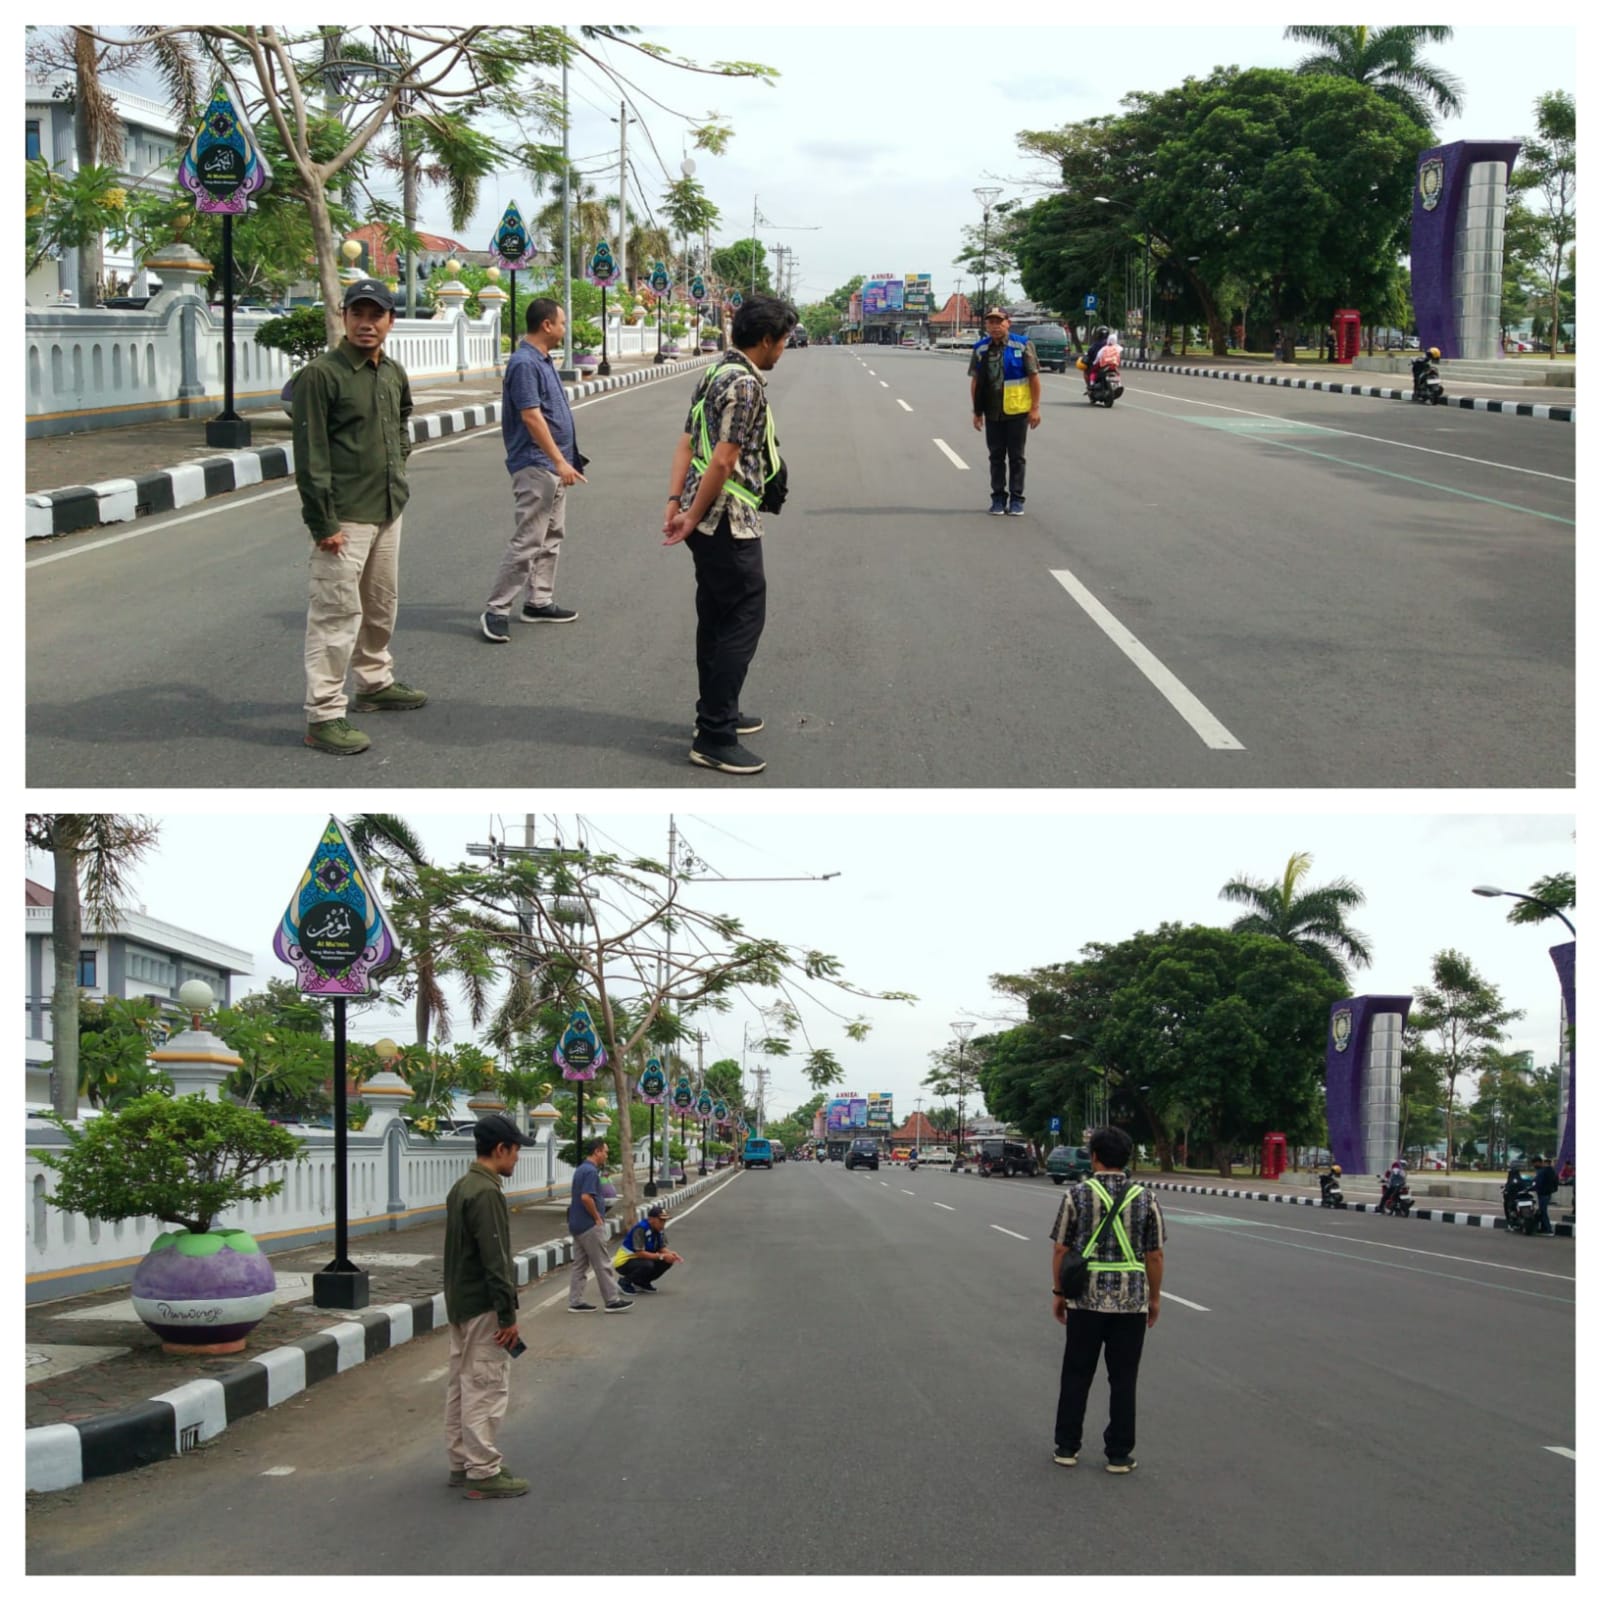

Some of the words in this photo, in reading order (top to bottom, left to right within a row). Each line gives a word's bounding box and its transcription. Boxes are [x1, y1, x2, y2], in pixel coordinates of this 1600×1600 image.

[1086, 295, 1095, 308] P
[329, 871, 337, 880] 6
[1051, 1118, 1059, 1128] P
